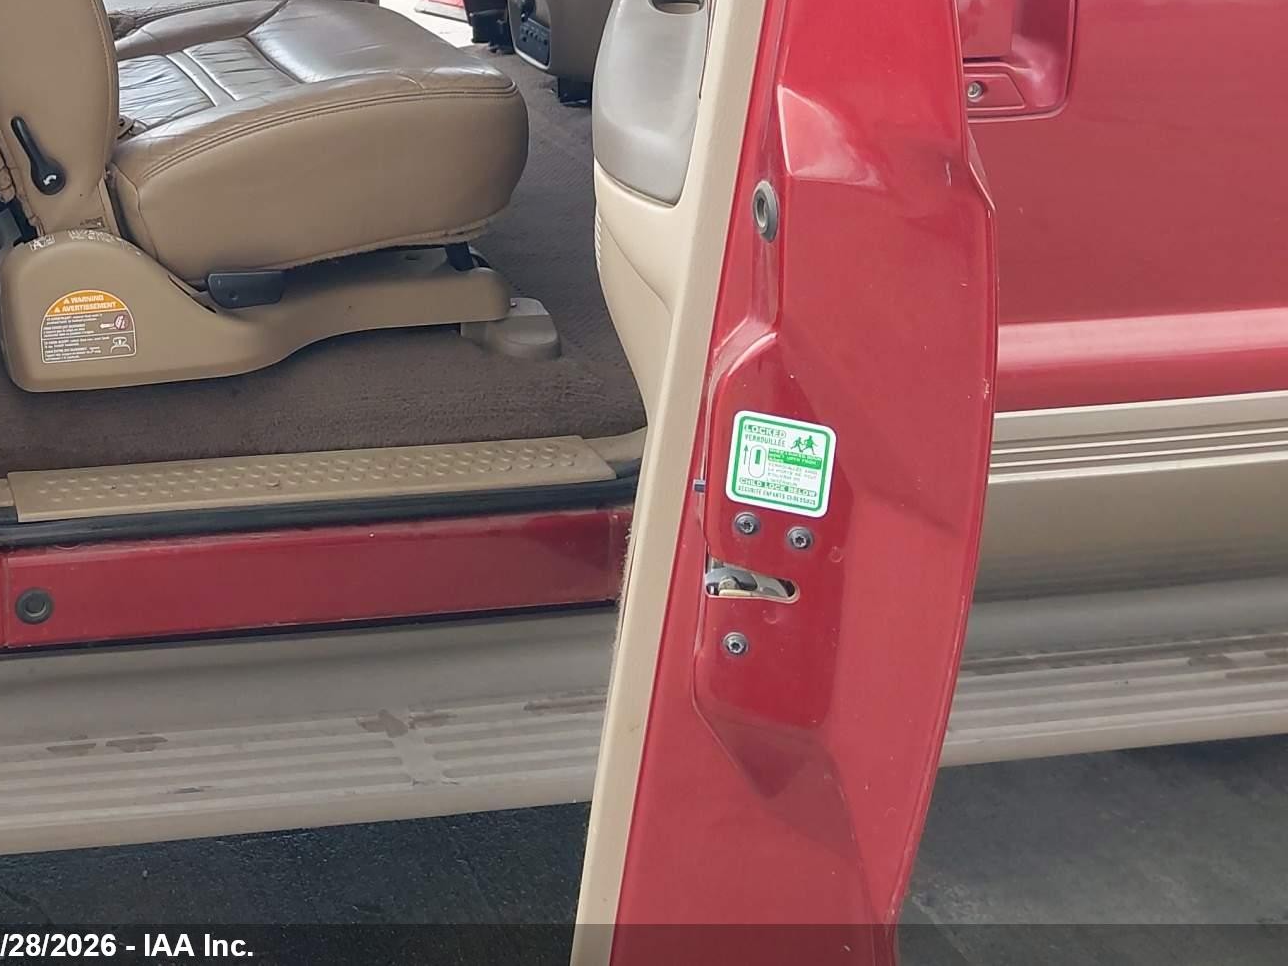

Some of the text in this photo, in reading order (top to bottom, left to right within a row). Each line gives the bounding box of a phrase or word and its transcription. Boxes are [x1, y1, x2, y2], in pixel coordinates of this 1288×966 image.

[71, 295, 104, 303] WARNING
[62, 301, 116, 312] AVERTISSEMENT
[744, 424, 786, 439] LOCKED
[740, 477, 817, 498] CHILD LOCK BELOW
